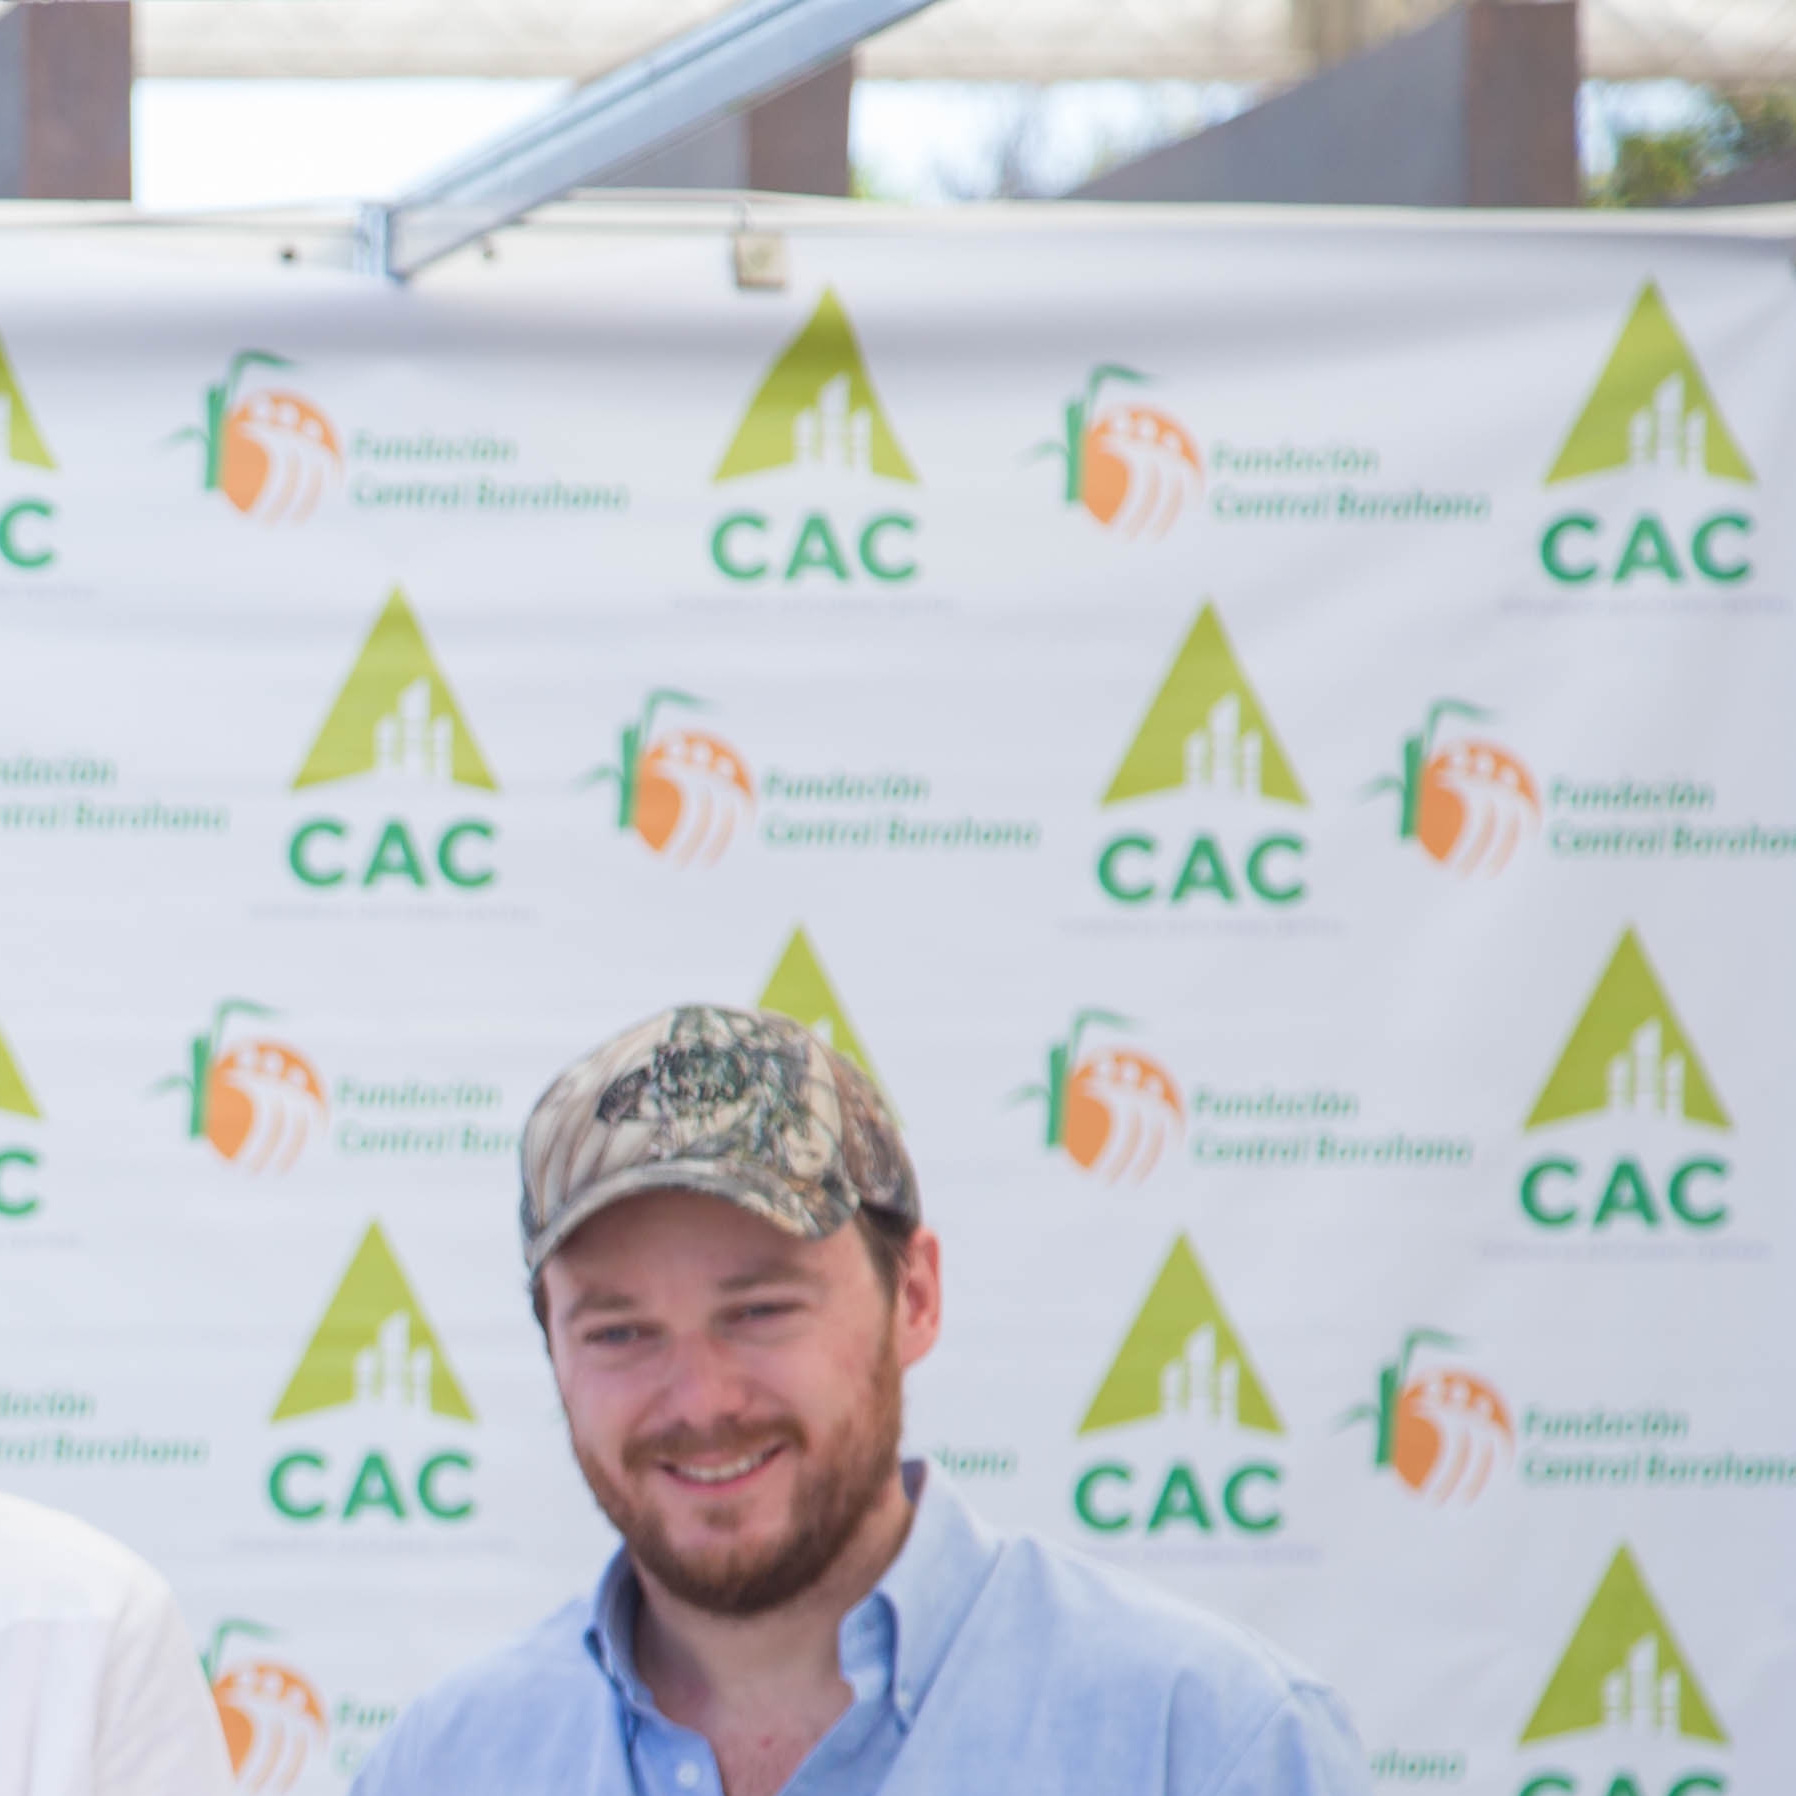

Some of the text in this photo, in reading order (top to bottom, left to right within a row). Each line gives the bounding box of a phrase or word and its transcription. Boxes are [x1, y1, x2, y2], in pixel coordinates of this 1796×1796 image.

[709, 512, 915, 583] CAC
[1538, 512, 1750, 585] CAC
[287, 819, 493, 890] CAC
[1096, 834, 1303, 904] CAC
[1519, 1157, 1726, 1229] CAC
[267, 1451, 471, 1522] CAC
[1073, 1463, 1279, 1534] CAC
